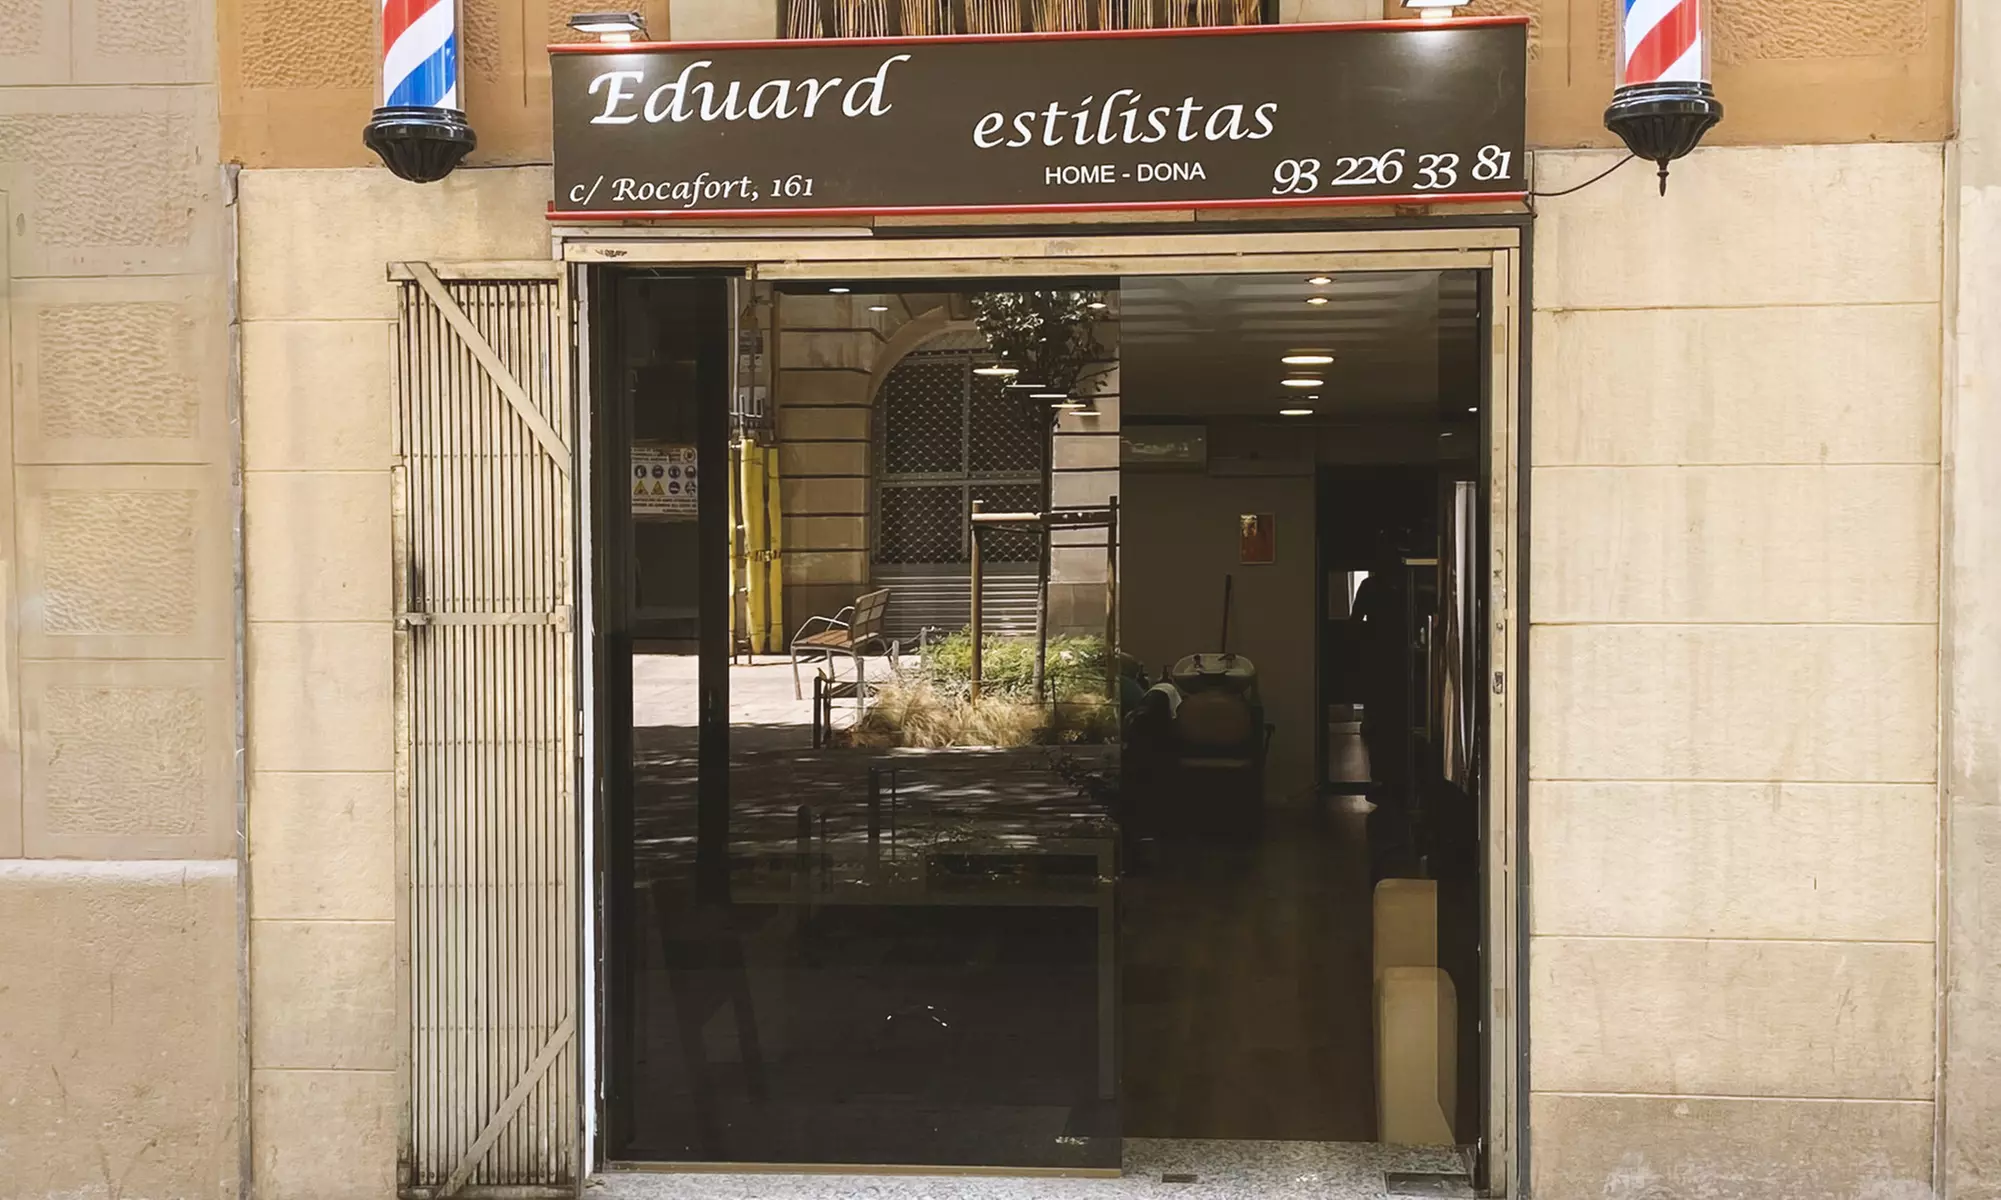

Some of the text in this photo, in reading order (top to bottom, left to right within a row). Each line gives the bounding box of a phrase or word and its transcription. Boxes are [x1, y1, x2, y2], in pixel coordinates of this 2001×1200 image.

[587, 54, 912, 125] Eduard
[973, 89, 1278, 148] estilistas
[569, 172, 815, 208] c/ Rocafort, 161
[1045, 166, 1116, 185] HOME
[1137, 162, 1206, 182] DONA
[1272, 144, 1513, 195] 93 226 33 81
